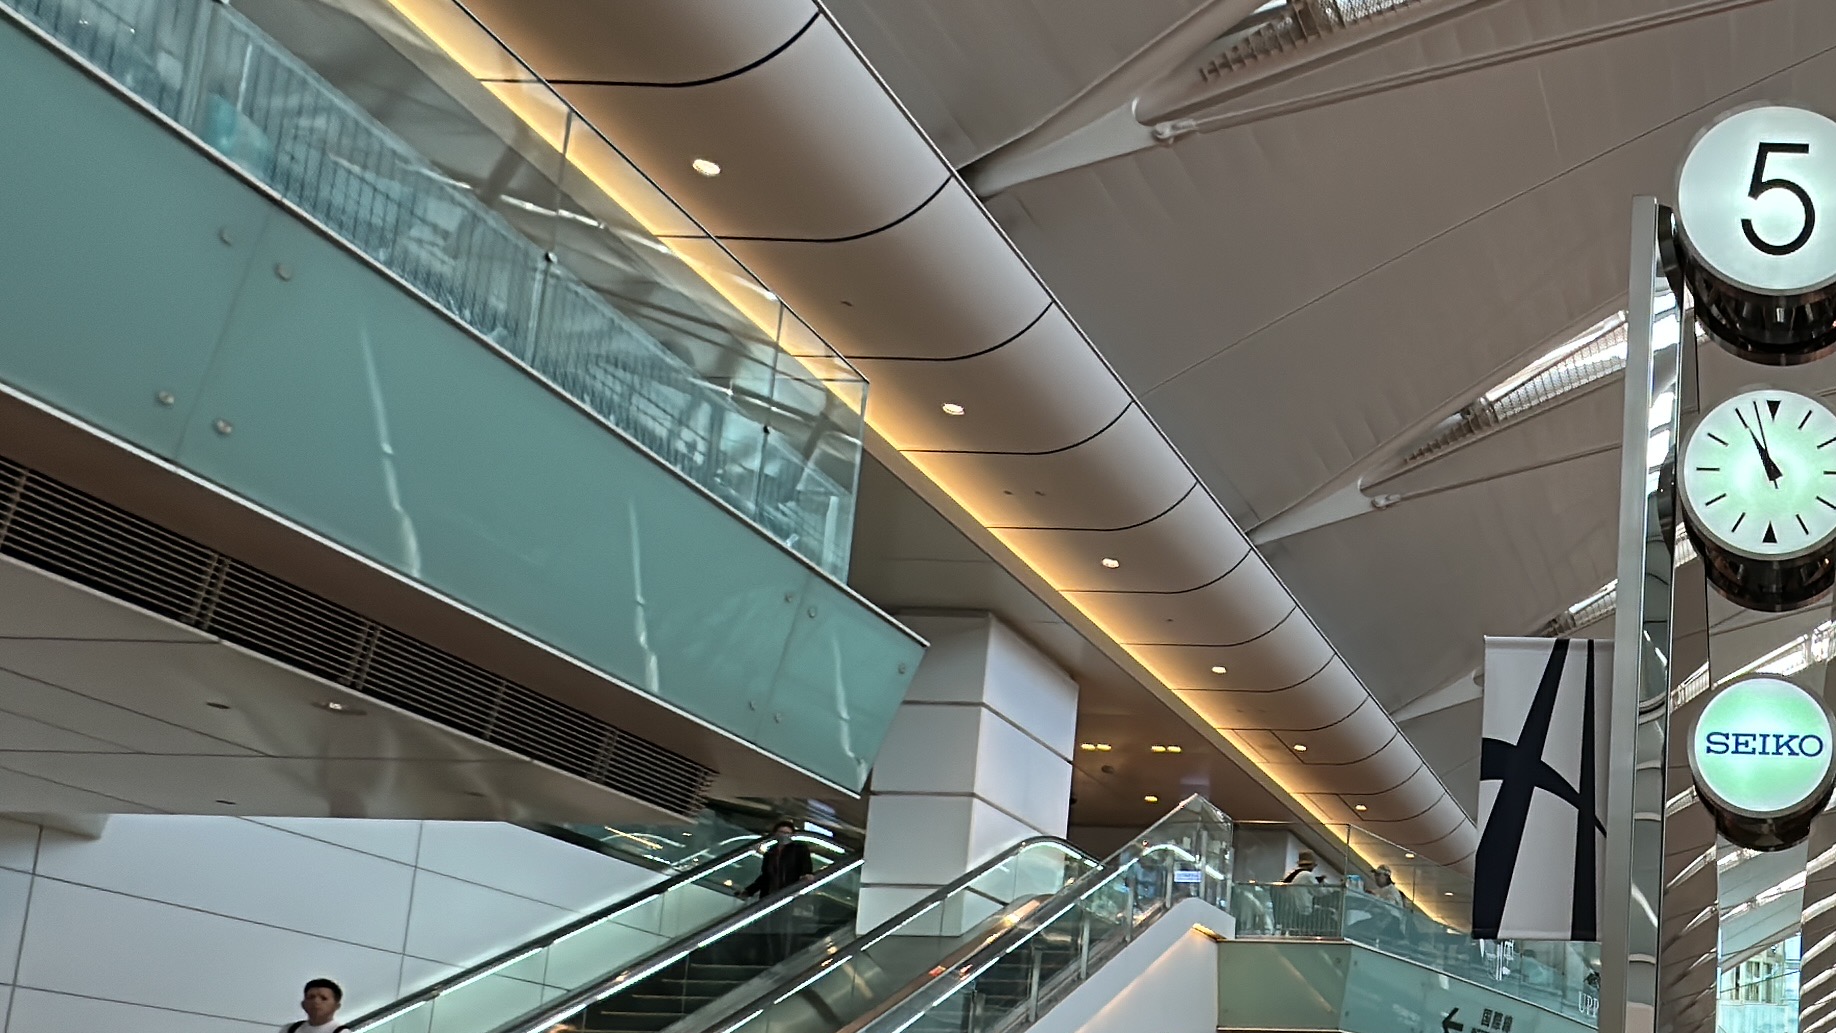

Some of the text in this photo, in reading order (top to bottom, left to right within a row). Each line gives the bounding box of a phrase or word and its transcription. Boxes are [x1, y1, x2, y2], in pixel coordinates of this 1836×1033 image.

[1741, 142, 1815, 256] 5
[1706, 732, 1823, 757] SEIKO
[1579, 990, 1600, 1018] UPP
